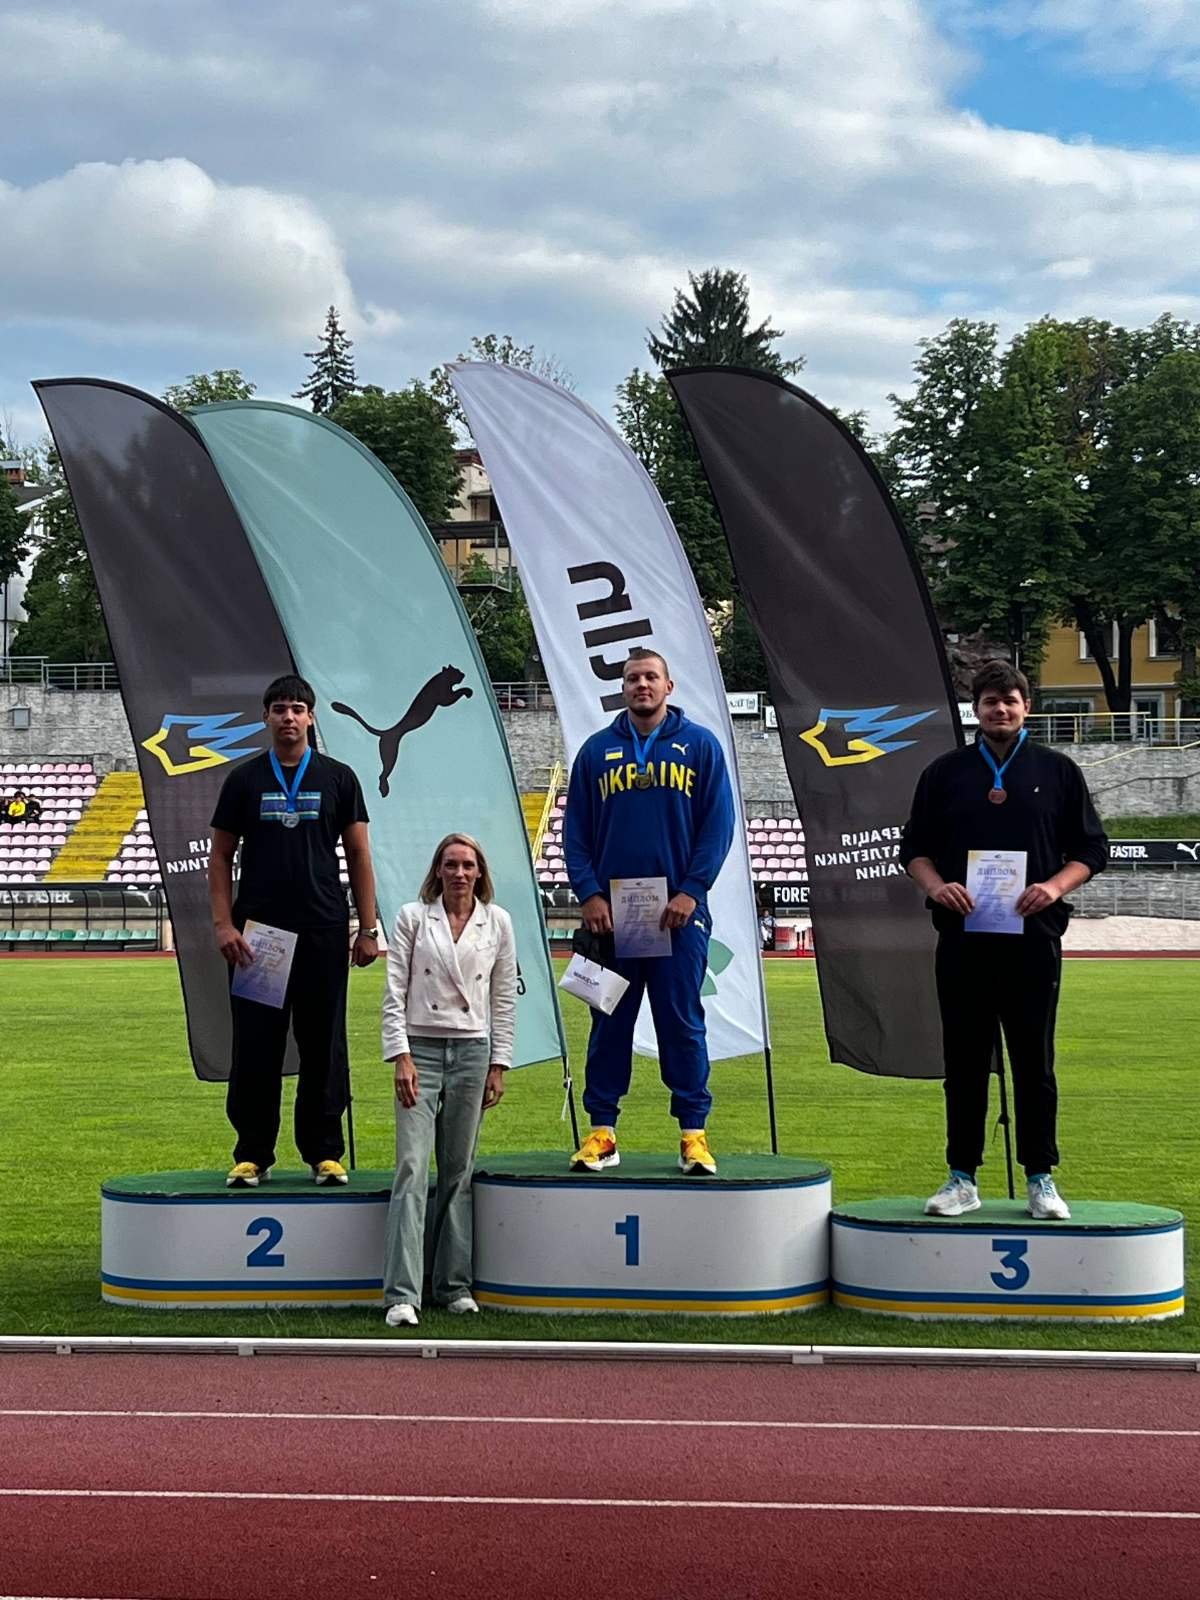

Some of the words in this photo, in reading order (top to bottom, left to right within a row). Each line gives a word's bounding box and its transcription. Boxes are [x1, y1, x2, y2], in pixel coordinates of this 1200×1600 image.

[598, 760, 697, 802] UKRAINE
[1109, 845, 1149, 858] FASTER.
[773, 886, 811, 903] FORE
[246, 1216, 285, 1268] 2
[615, 1215, 640, 1266] 1
[990, 1238, 1030, 1291] 3
